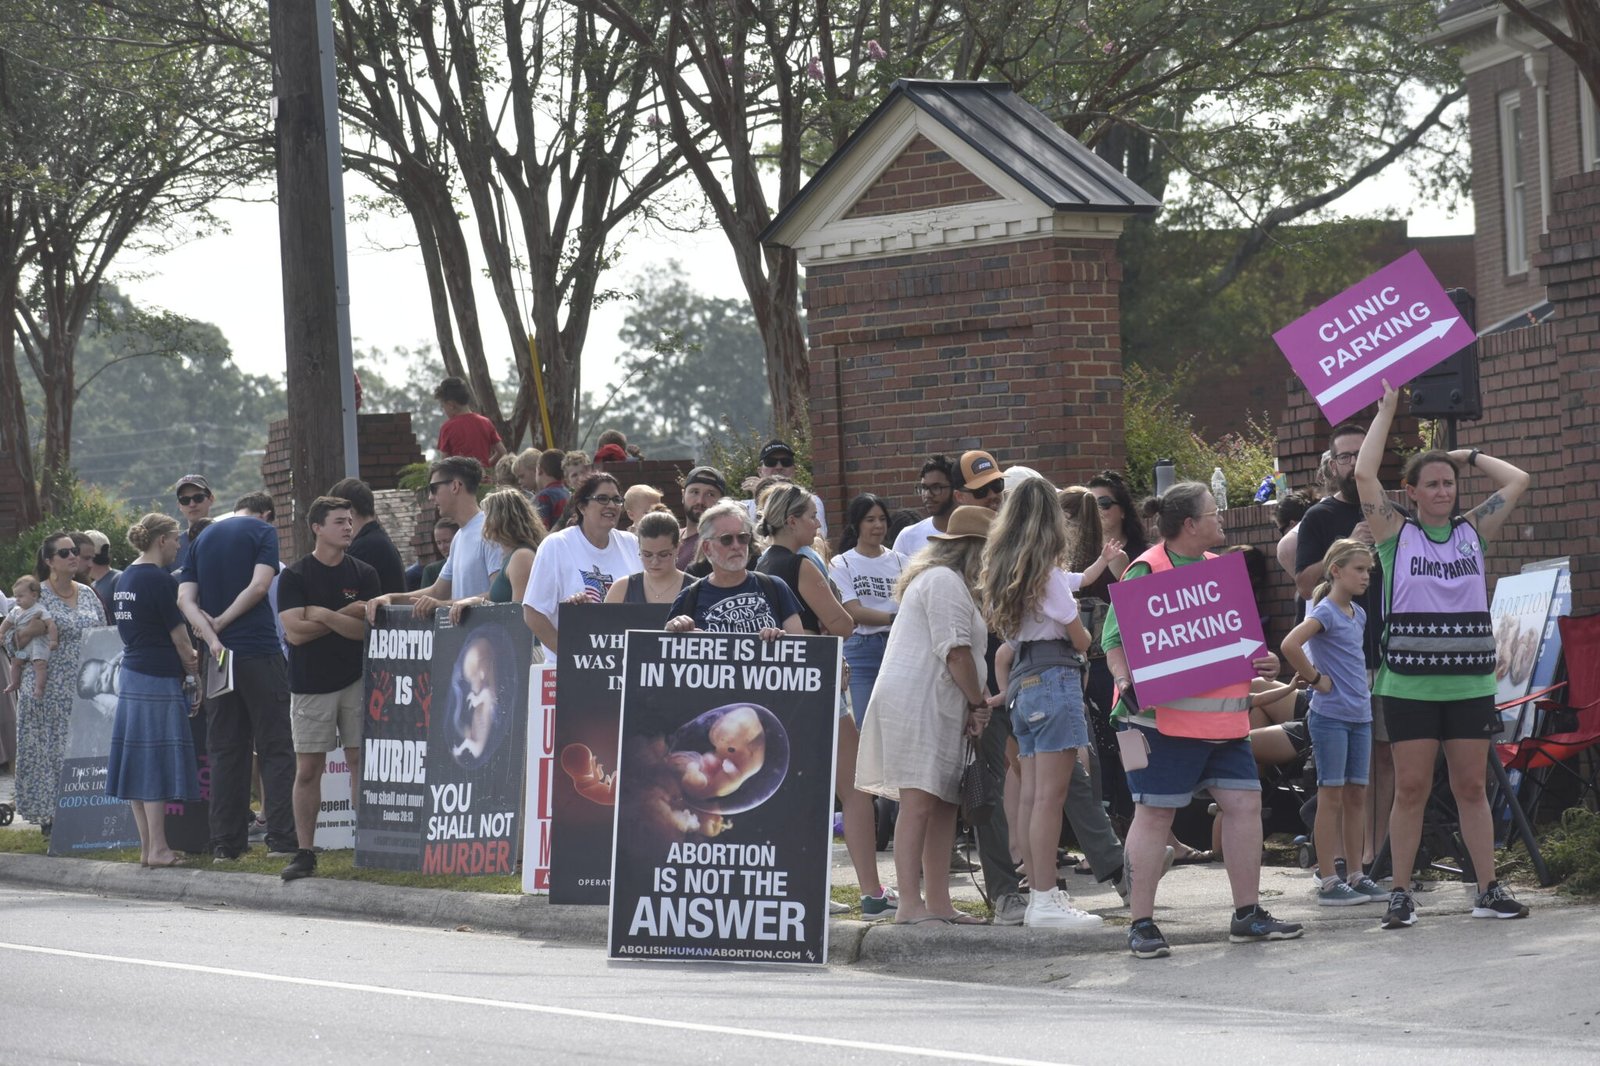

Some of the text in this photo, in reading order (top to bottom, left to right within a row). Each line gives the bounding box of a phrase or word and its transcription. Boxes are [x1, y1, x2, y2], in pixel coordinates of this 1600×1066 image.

[1319, 286, 1400, 342] CLINIC
[1318, 302, 1431, 377] PARKING
[869, 576, 884, 584] THE
[1442, 555, 1480, 580] PARKIN
[854, 581, 871, 590] SAVE
[871, 583, 885, 591] THE
[872, 590, 886, 598] THE
[1147, 580, 1221, 617] CLINIC
[724, 606, 755, 624] SONS
[368, 629, 434, 660] ABORTIO
[589, 634, 624, 649] WH
[1141, 609, 1242, 654] PARKING
[572, 654, 616, 669] WAS
[658, 637, 807, 663] THERE IS LIFE
[395, 675, 413, 705] IS
[640, 662, 664, 687] IN
[671, 663, 736, 690] YOUR
[742, 666, 821, 692] WOMB
[363, 738, 427, 784] MURDE
[64, 782, 90, 792] LOOKS
[379, 791, 395, 805] shall
[396, 793, 407, 806] not
[430, 782, 472, 814] YOU
[320, 799, 350, 813] epent
[426, 812, 514, 841] SHALL NOT
[422, 841, 510, 876] MURDER
[666, 842, 776, 867] ABORTION
[653, 867, 788, 897] IS NOT THE
[628, 896, 806, 942] ANSWER
[618, 944, 801, 960] ABOLISHHUMANABORTION.COM
